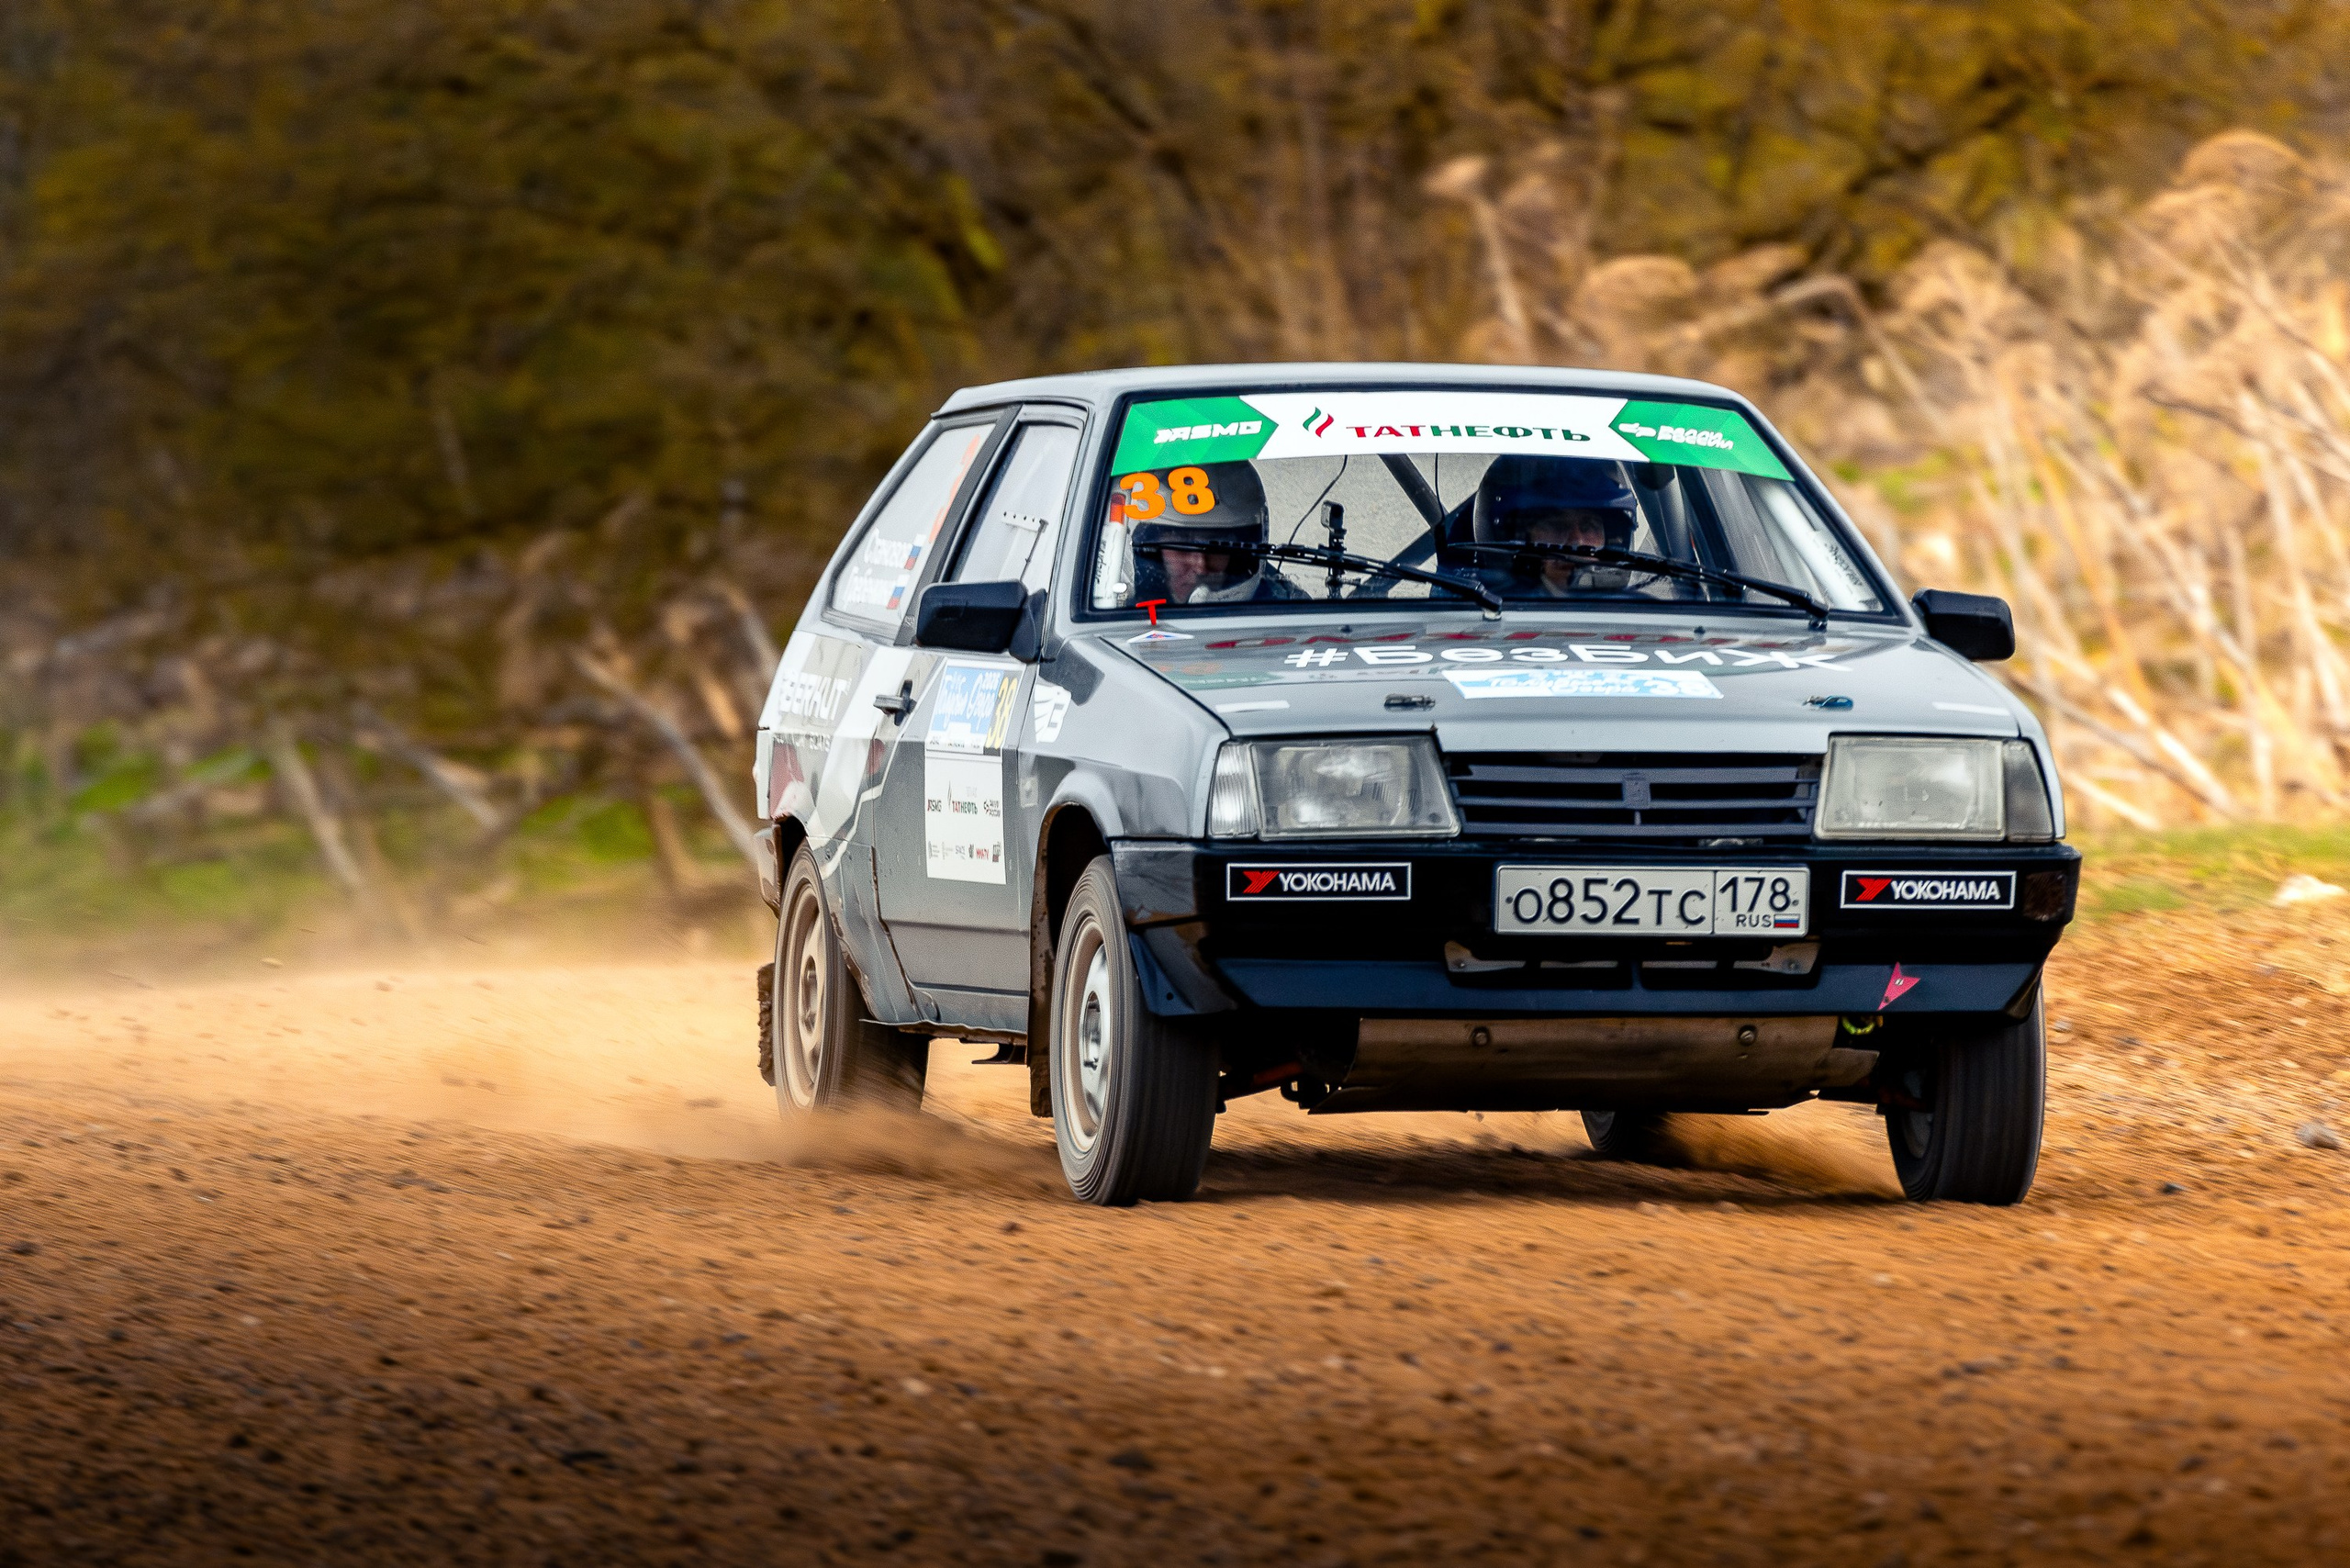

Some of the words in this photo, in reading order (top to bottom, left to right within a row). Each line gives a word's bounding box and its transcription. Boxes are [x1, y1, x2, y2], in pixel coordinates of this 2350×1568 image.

[1345, 424, 1591, 442] ТАТНЕФТЬ
[1119, 466, 1216, 521] 38
[1279, 872, 1396, 891] YOKOHAMA
[1890, 880, 2001, 900] YOKOHAMA
[1718, 876, 1791, 913] 178
[1735, 914, 1773, 928] RUS
